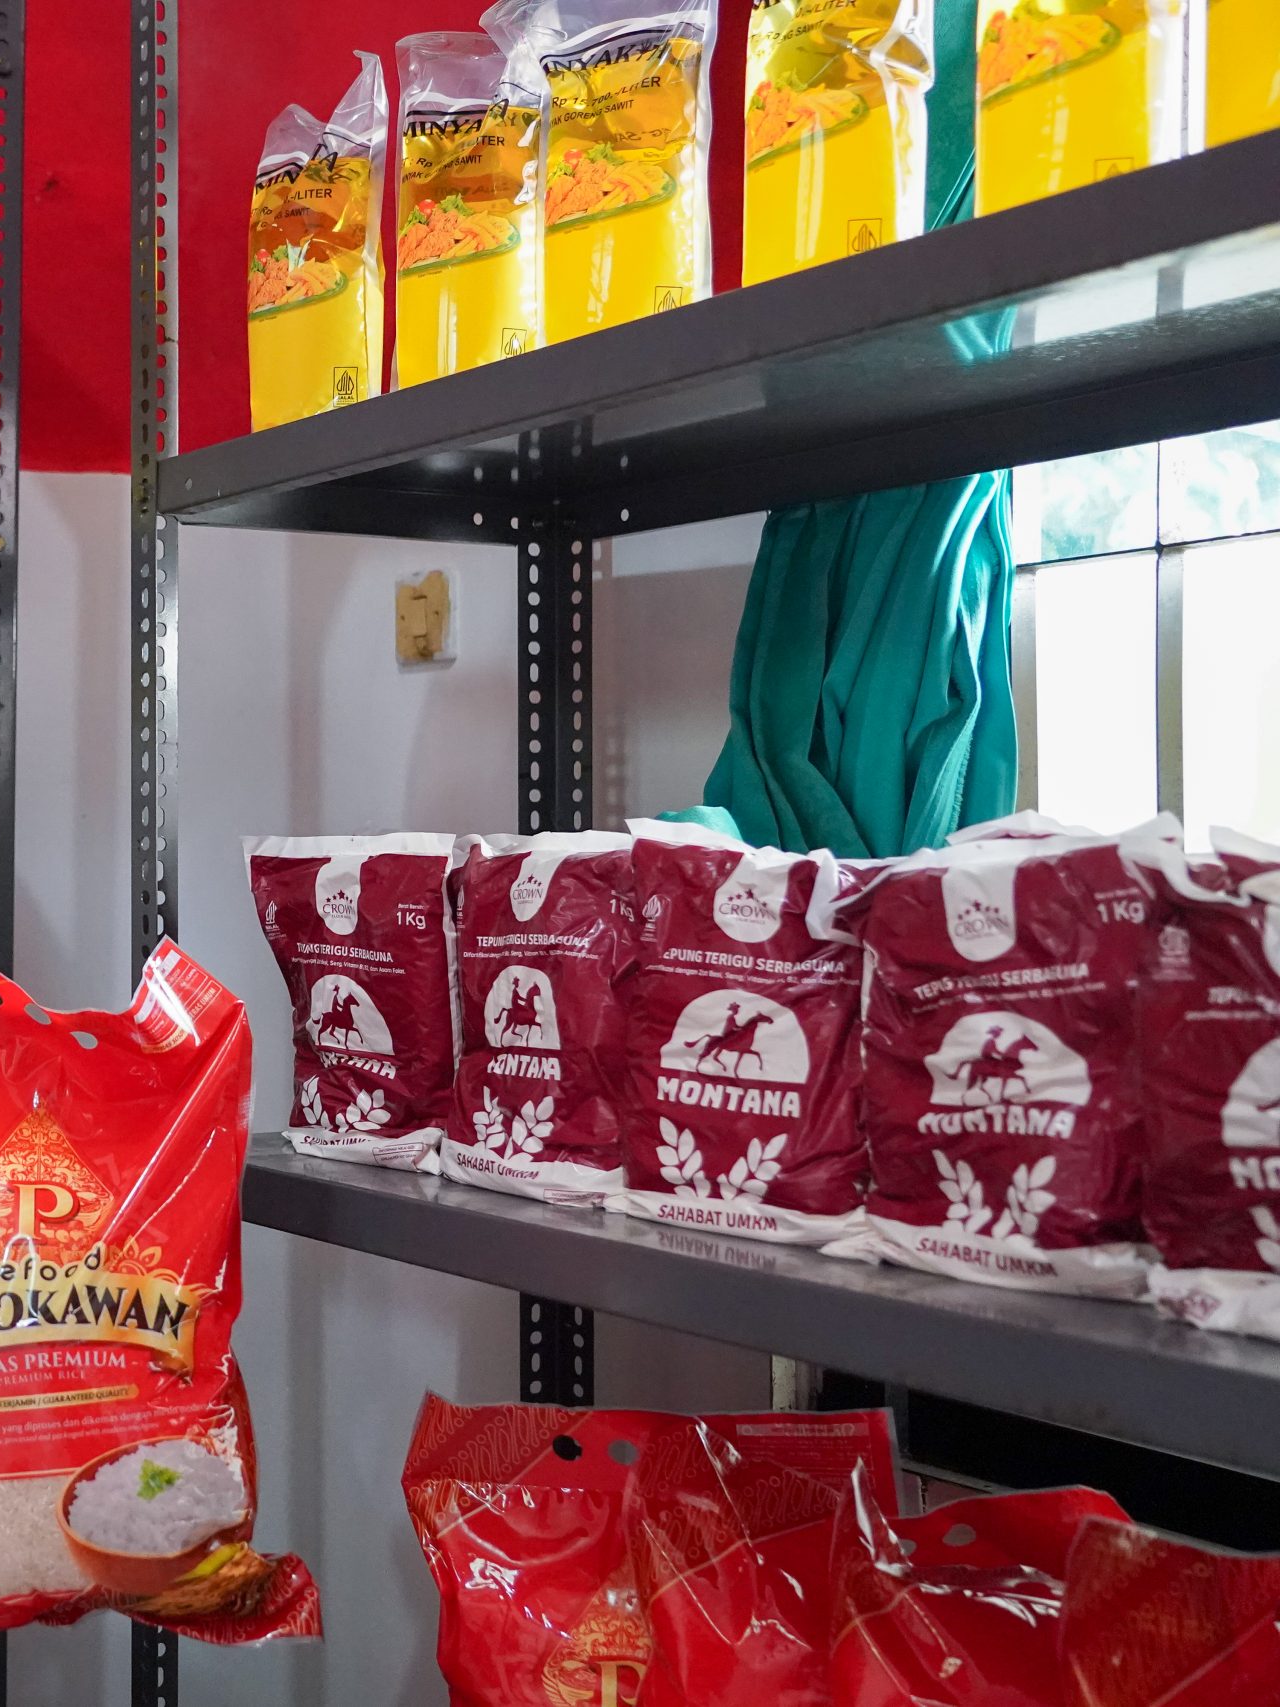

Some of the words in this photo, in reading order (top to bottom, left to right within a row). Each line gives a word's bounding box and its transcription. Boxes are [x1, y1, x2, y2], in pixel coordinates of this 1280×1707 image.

[552, 96, 567, 108] Rp
[564, 109, 602, 122] GORENG
[605, 100, 634, 112] SAWIT
[513, 888, 544, 902] CROWN
[609, 899, 616, 914] 1
[719, 902, 778, 921] CROWN
[1097, 904, 1108, 923] 1
[1113, 900, 1146, 924] Kg
[396, 911, 402, 926] 1
[406, 911, 427, 929] Kg
[705, 951, 753, 969] TERIGU
[755, 957, 844, 974] SERBAGUNA
[657, 1076, 800, 1118] MONTANA
[457, 1153, 495, 1174] SAHABAT
[658, 1204, 723, 1226] SAHABAT
[726, 1210, 778, 1231] UMKM
[916, 1237, 991, 1268] SAHABAT
[995, 1254, 1058, 1277] UMKM
[24, 1350, 127, 1370] PREMIUM
[58, 1369, 87, 1381] RICE
